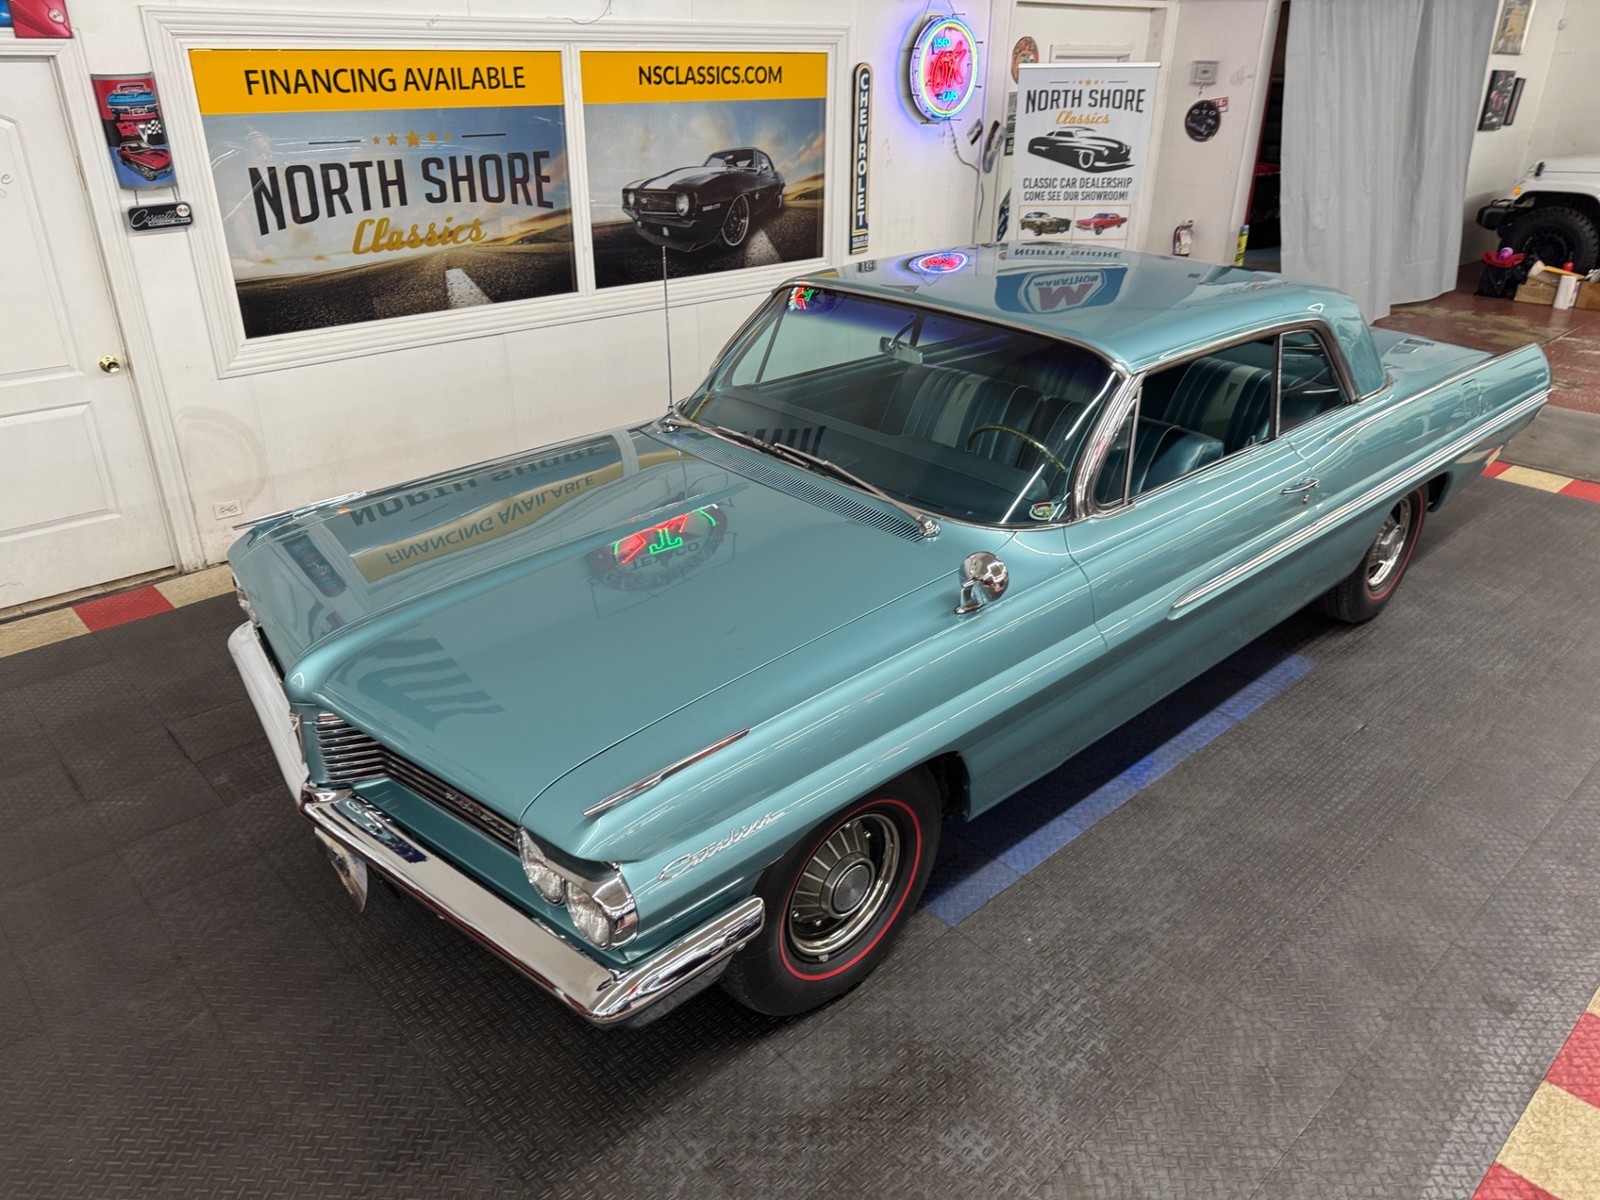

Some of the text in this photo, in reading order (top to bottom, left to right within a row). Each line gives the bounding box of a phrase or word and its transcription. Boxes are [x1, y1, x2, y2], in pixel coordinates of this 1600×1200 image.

[243, 65, 526, 95] FINANCING AVAILABLE
[637, 64, 783, 87] NSCLASSICS.COM
[1025, 88, 1147, 114] NORTH SHORE
[1055, 110, 1111, 125] Classics
[856, 73, 870, 226] CHEVROLET
[248, 150, 554, 236] NORTH SHORE
[1022, 177, 1133, 189] CLASSIC CAR DEALERSHIP
[1023, 191, 1129, 201] COME SEE OUR SHOWROOM!
[351, 215, 488, 256] Classics
